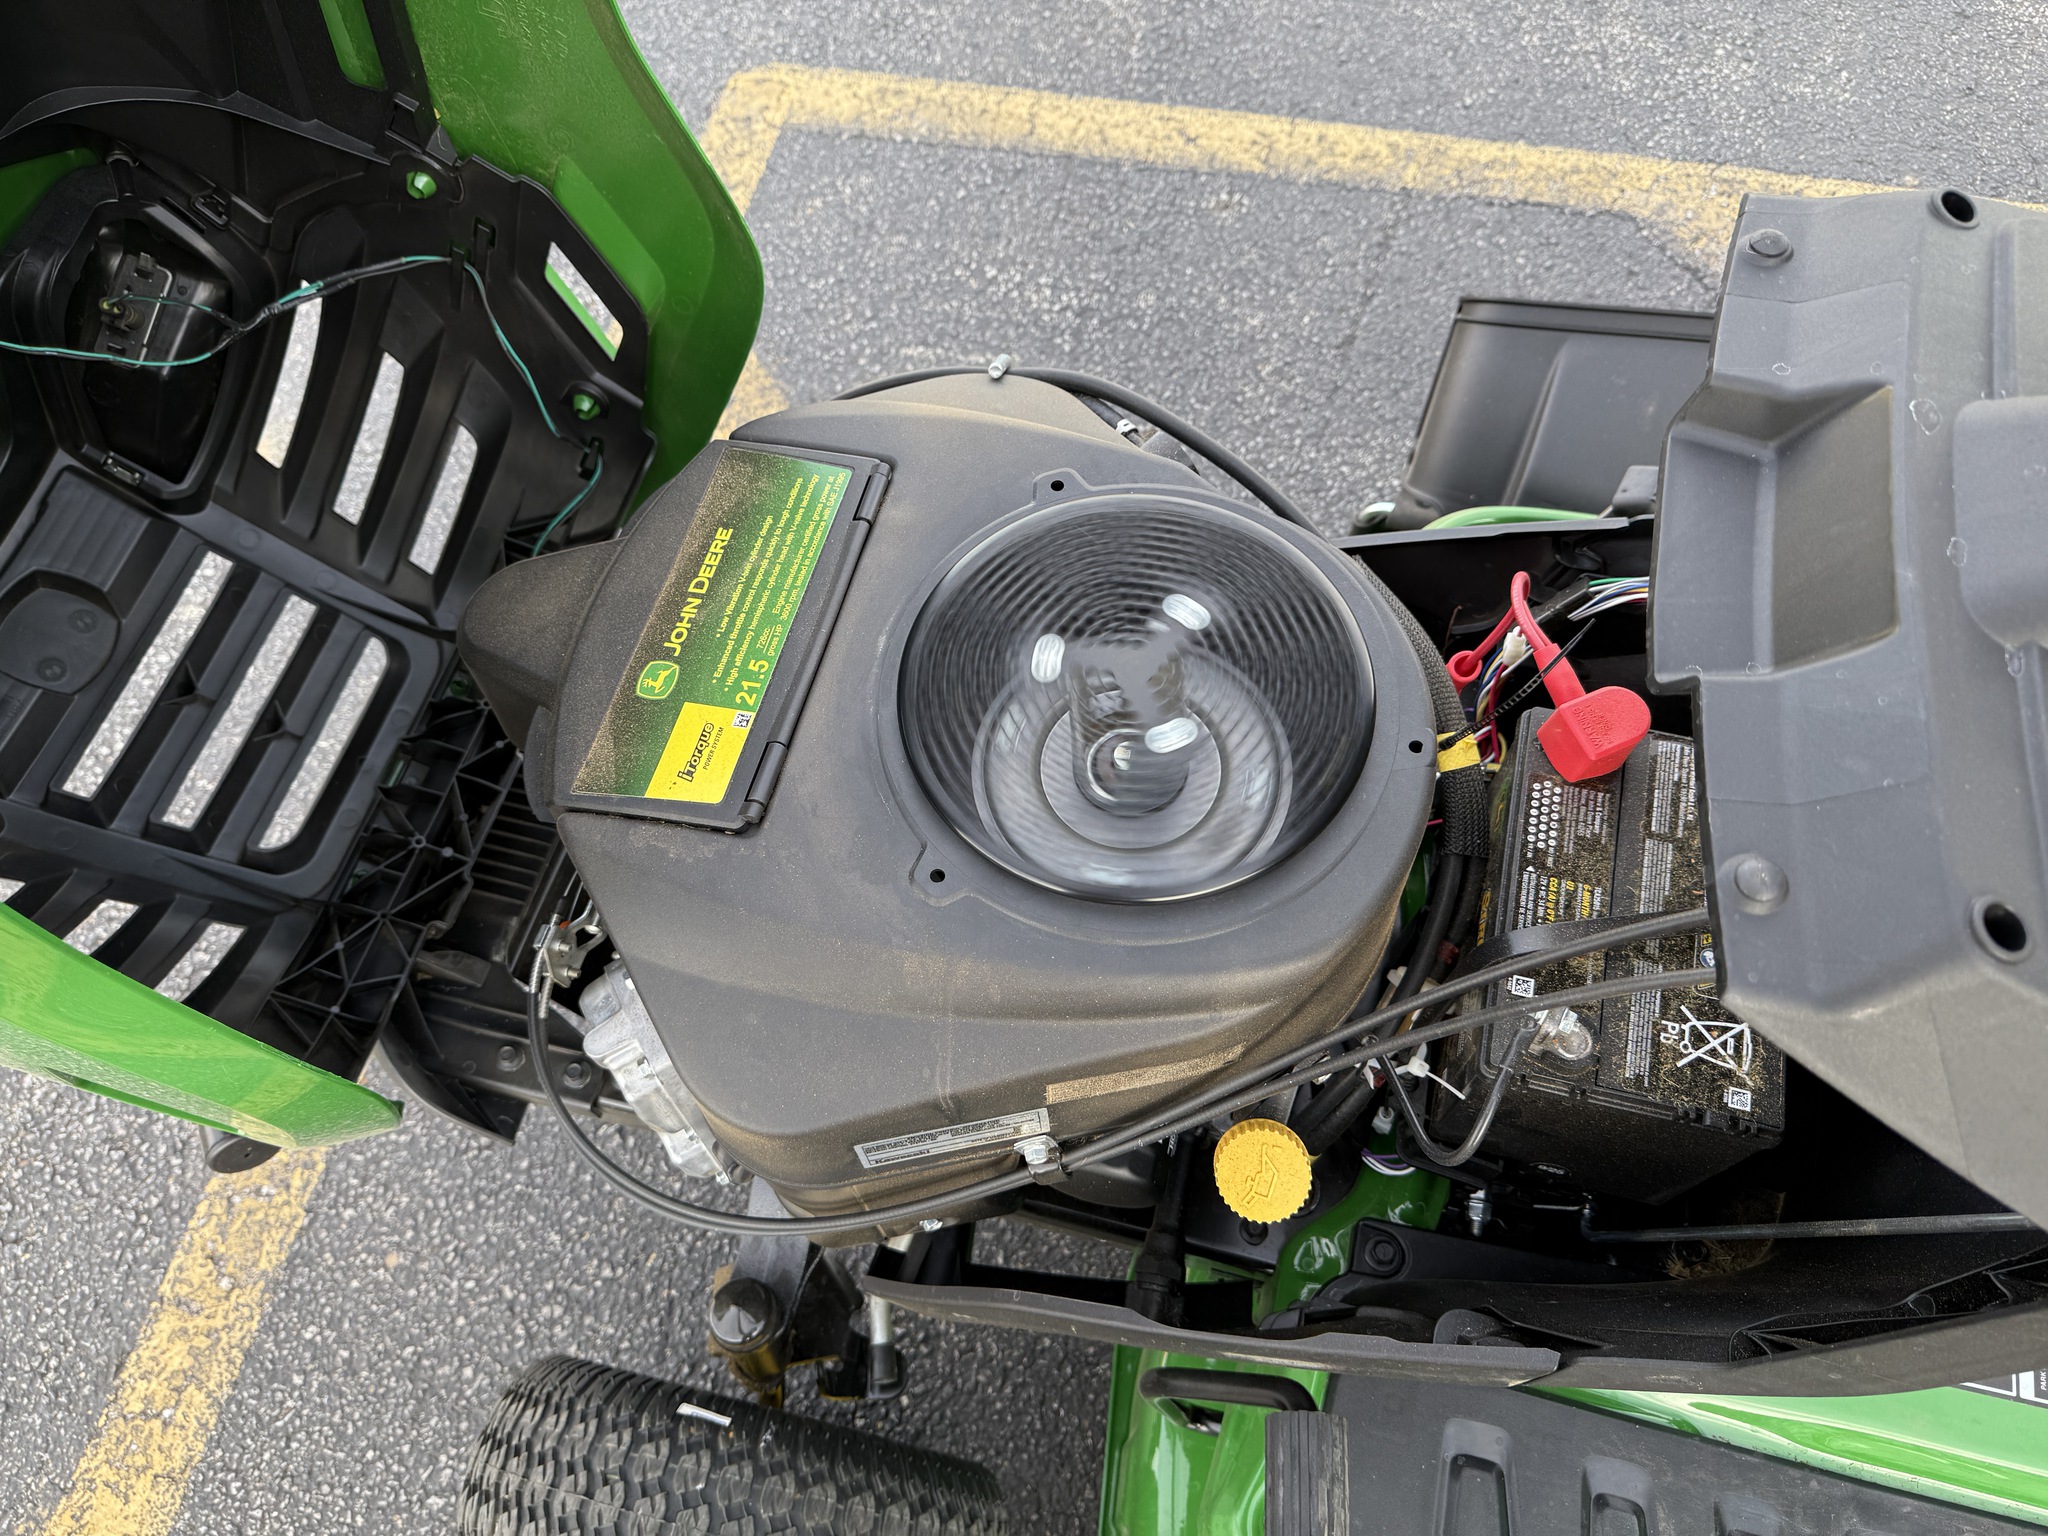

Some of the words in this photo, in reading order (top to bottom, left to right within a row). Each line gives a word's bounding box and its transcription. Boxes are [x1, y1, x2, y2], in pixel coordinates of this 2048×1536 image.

[718, 615, 728, 631] Low
[724, 583, 742, 614] Vibration
[739, 562, 751, 581] V-twin
[749, 537, 762, 560] cylinder
[759, 515, 772, 535] design
[771, 589, 787, 613] Engine
[783, 547, 804, 588] manufacturer
[801, 521, 815, 545] certified
[812, 503, 822, 521] gross
[819, 483, 830, 502] power
[780, 603, 790, 619] 3600
[795, 564, 806, 585] tested
[803, 557, 810, 565] in
[807, 521, 825, 557] accordance
[826, 493, 836, 505] SAE
[833, 472, 844, 490] J1995
[663, 597, 701, 656] JOHN
[687, 527, 732, 593] DEERE
[713, 639, 733, 676] Enhanced
[729, 612, 745, 638] throttle
[742, 588, 755, 611] control
[752, 557, 768, 587] responds
[765, 535, 778, 557] quickly
[777, 509, 789, 526] tough
[786, 477, 802, 507] conditions
[725, 667, 738, 684] High
[734, 630, 753, 666] efficiency
[748, 589, 769, 628] hemispheric
[766, 563, 780, 588] cylinder
[777, 546, 787, 562] head
[785, 532, 793, 544] with
[790, 507, 804, 530] V-valve
[799, 474, 818, 507] technology
[755, 627, 771, 647] 726cc
[767, 636, 778, 655] gross
[774, 623, 782, 634] HP
[734, 659, 768, 705] 21.5
[676, 722, 714, 782] iTorque
[702, 749, 715, 770] POWER
[711, 726, 724, 749] SYSTEM
[1548, 877, 1557, 891] CCA
[1661, 1020, 1679, 1044] Pb
